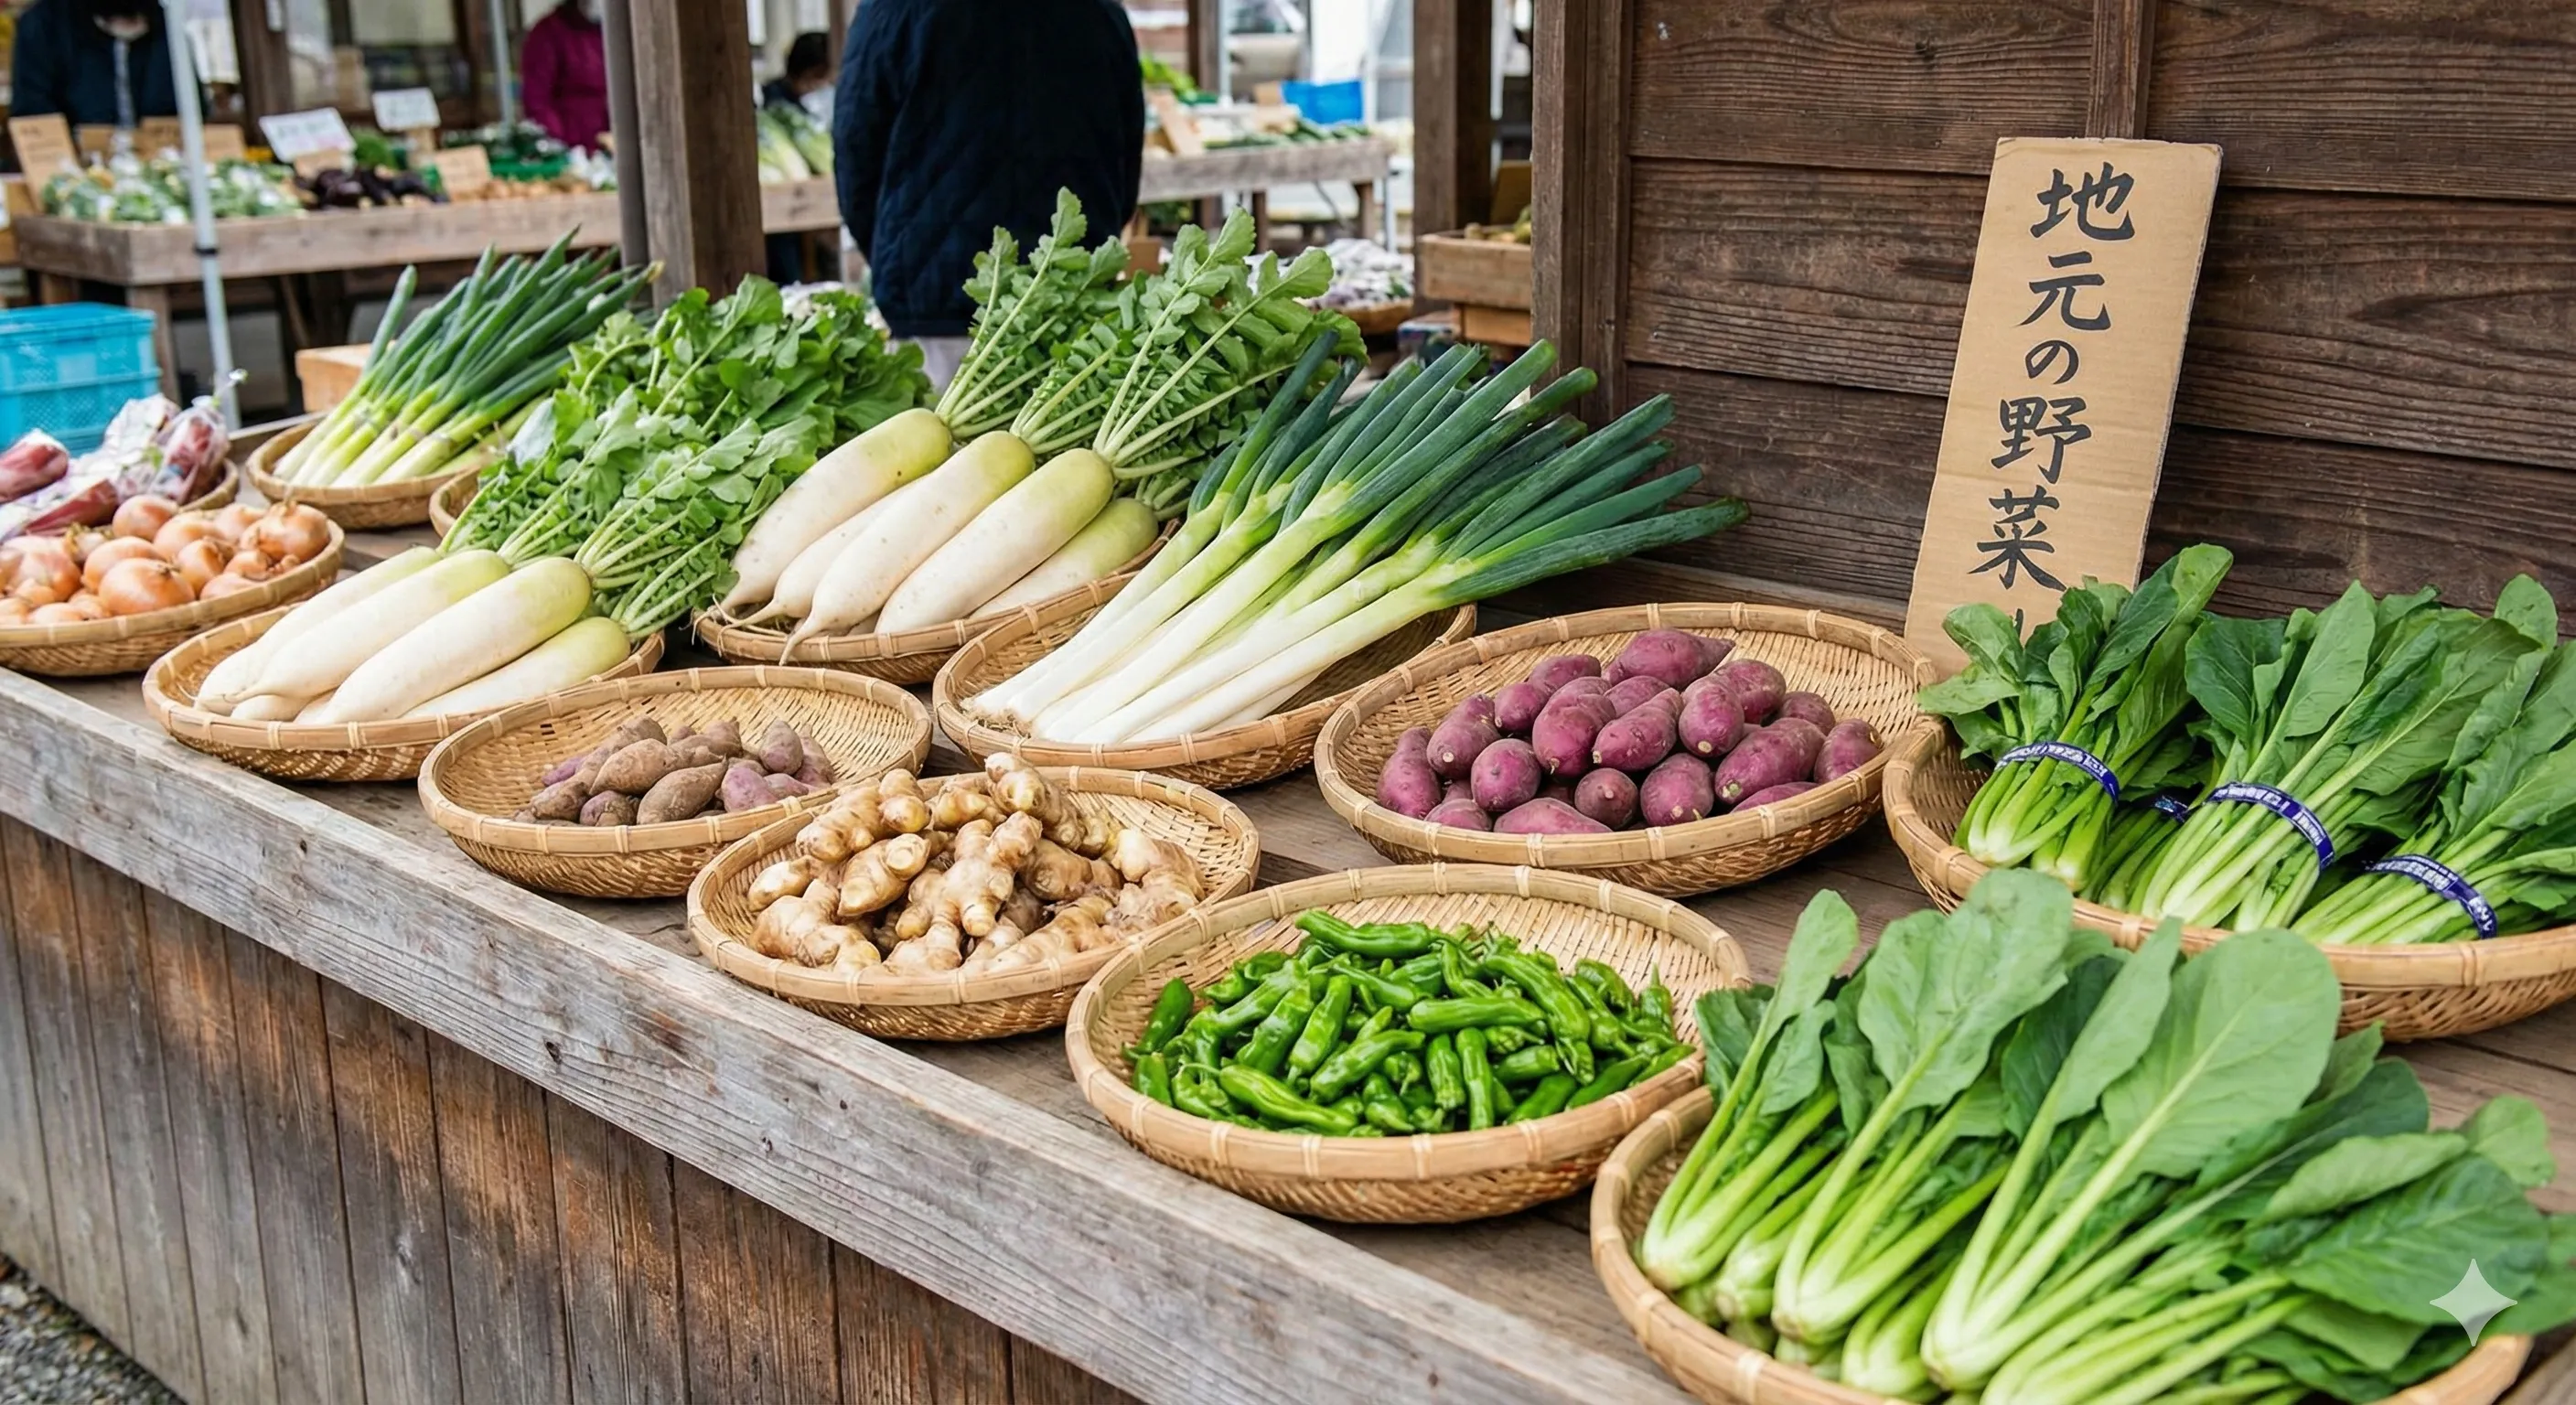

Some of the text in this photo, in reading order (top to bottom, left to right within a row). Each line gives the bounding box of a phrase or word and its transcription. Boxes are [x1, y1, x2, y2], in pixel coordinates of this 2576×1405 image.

[1968, 162, 2135, 638] 地元の野菜
